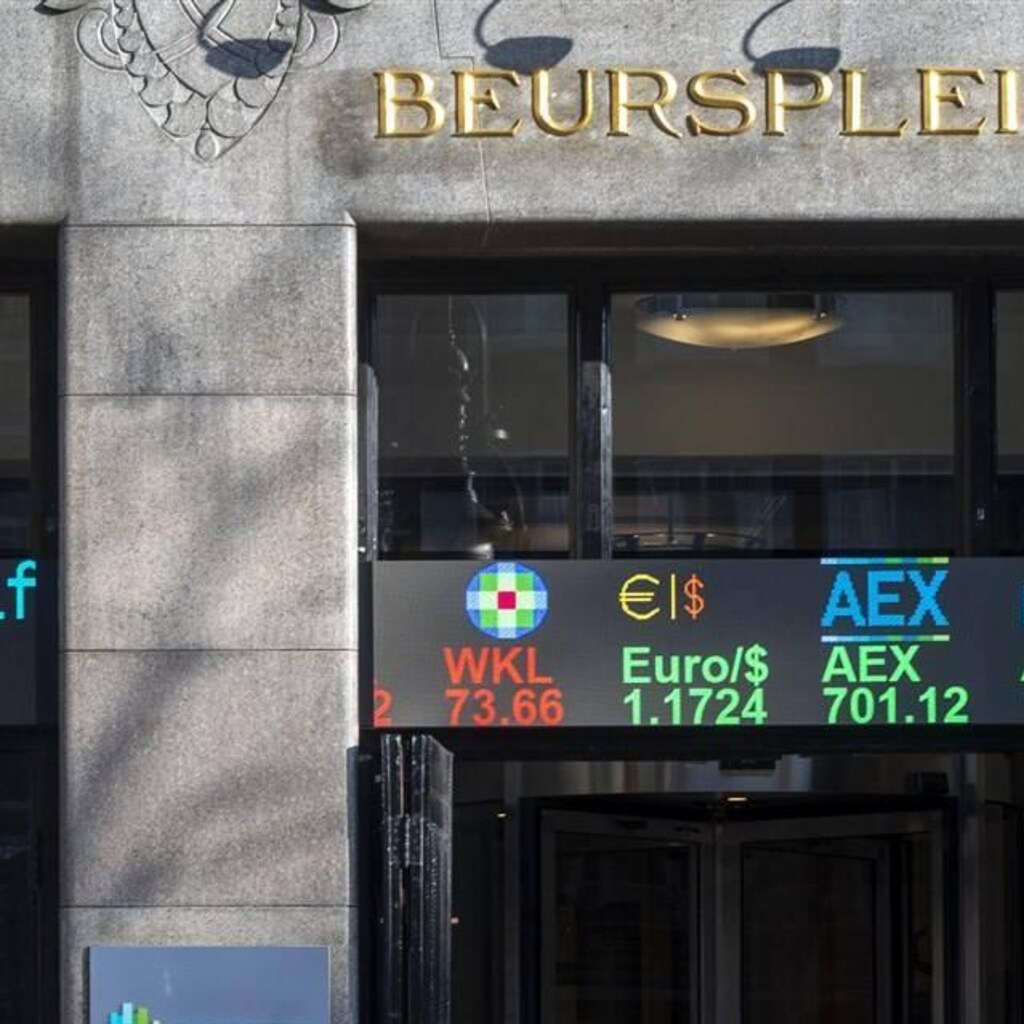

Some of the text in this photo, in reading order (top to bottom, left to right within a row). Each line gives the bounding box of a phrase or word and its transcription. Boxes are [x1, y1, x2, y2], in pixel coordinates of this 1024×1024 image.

[373, 67, 1020, 138] BEURSPLEI
[820, 570, 949, 627] AEX
[443, 646, 553, 684] WKL
[622, 643, 770, 686] Euro/$
[821, 645, 921, 683] AEX
[444, 687, 565, 727] 73.66
[623, 687, 769, 726] 1.1724
[822, 686, 969, 724] 701.12
